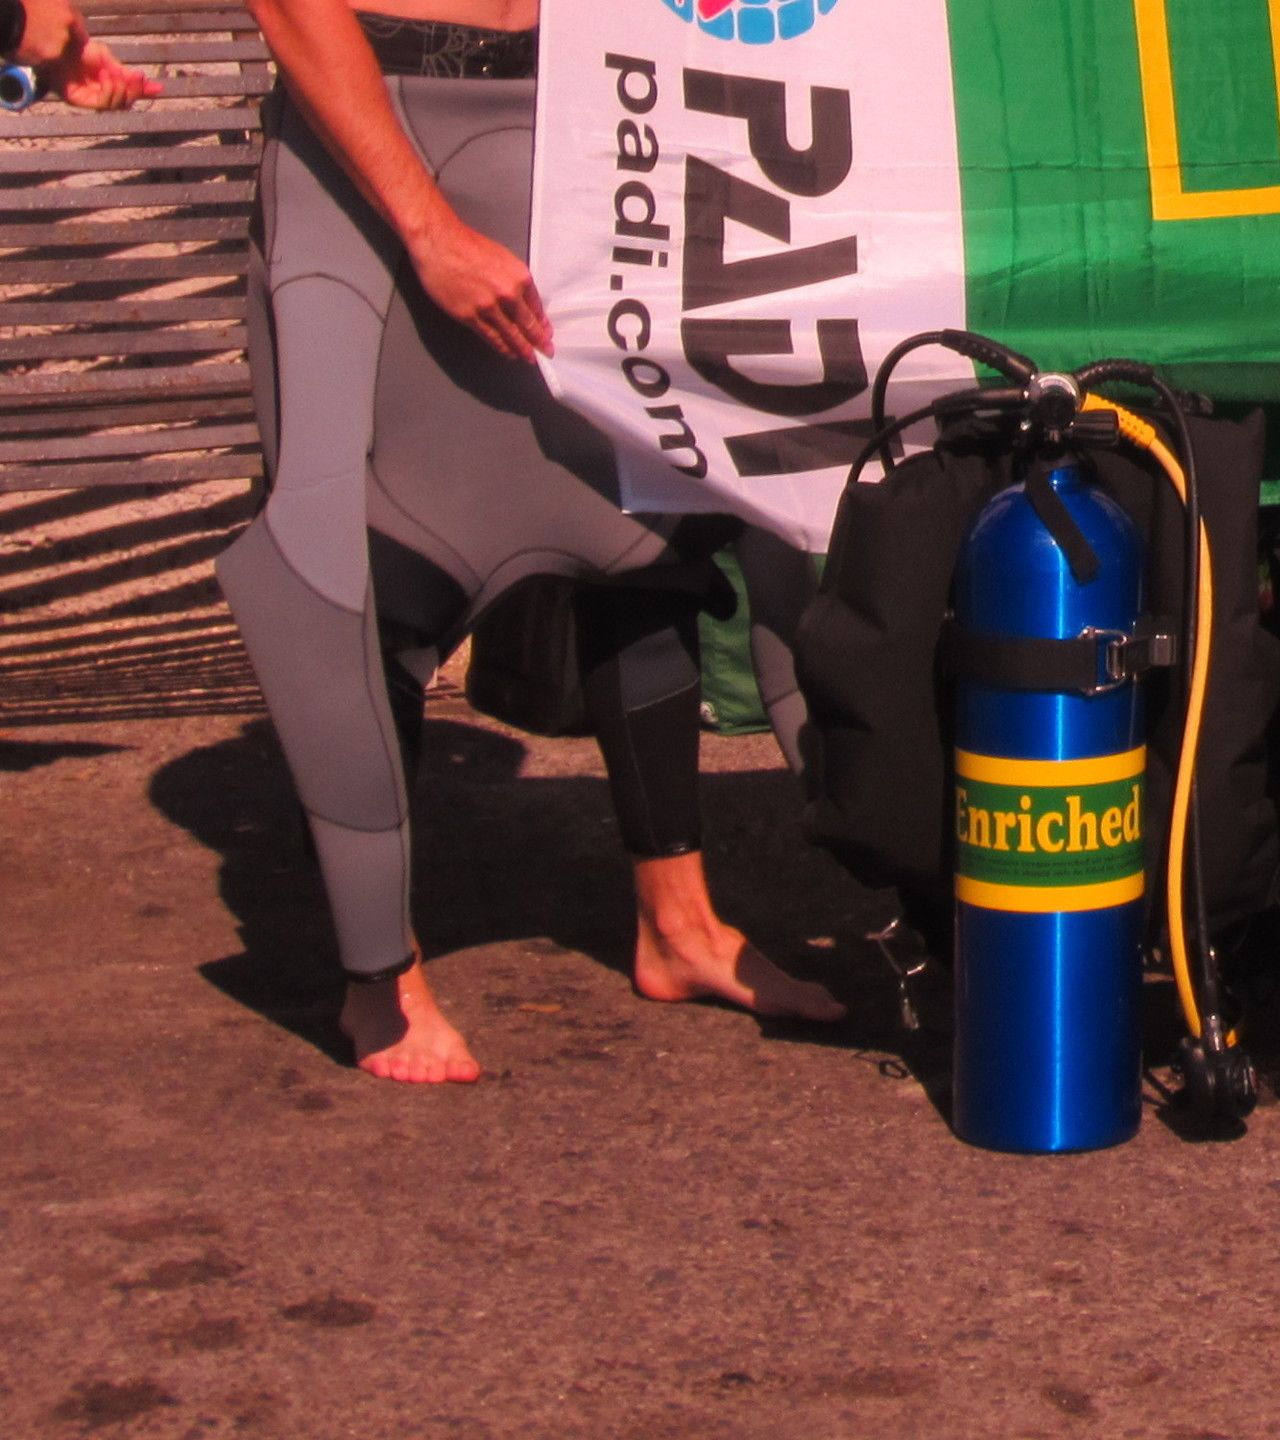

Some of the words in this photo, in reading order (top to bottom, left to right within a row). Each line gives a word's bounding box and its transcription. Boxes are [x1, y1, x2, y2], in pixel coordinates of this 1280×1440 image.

[604, 51, 708, 479] padi.com
[680, 66, 905, 478] PADI
[955, 783, 1141, 853] Enriched
